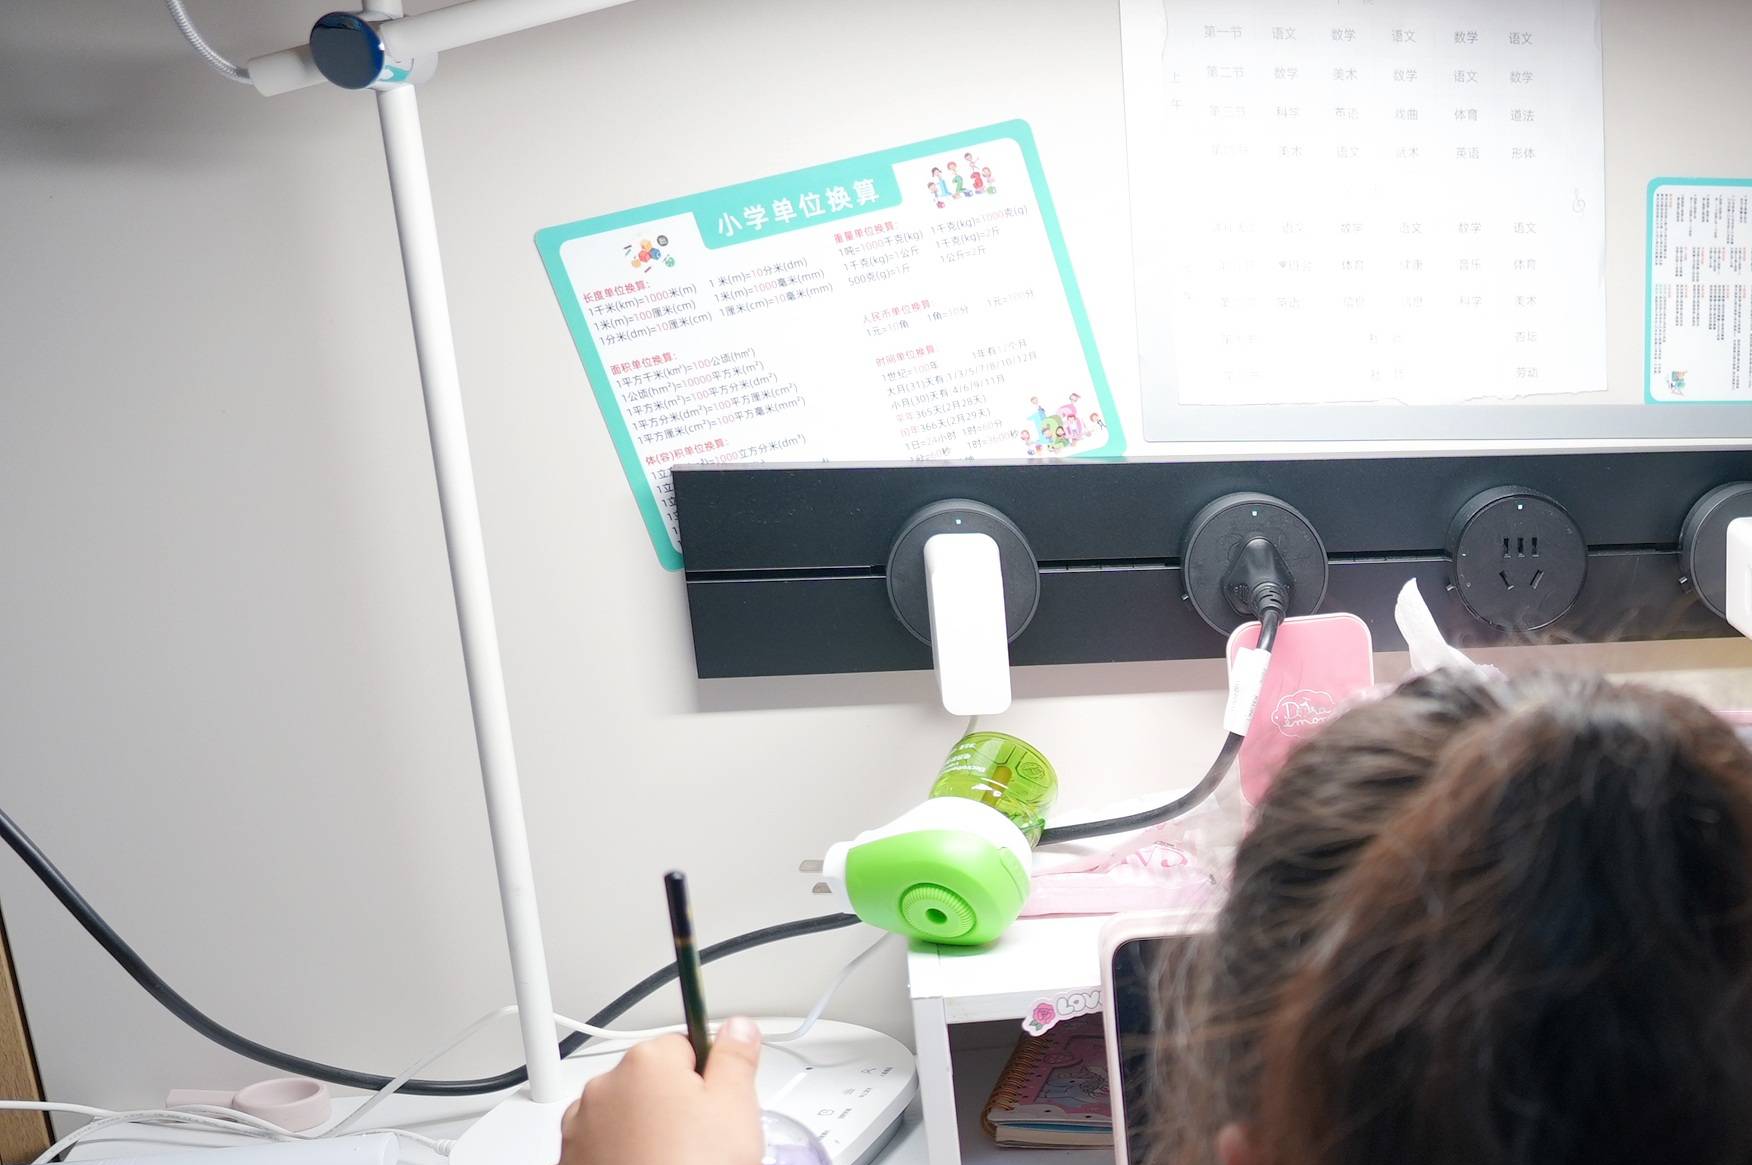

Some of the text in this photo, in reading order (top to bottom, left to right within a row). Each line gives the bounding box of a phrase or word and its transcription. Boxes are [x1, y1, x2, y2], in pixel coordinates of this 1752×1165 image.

[1204, 25, 1243, 40] 第一节
[1272, 27, 1297, 40] 语文
[1332, 28, 1357, 42] 数学
[1392, 30, 1417, 43] 语文
[1454, 31, 1479, 45] 数学
[1509, 32, 1534, 46] 语文
[1206, 65, 1246, 80] 第二节
[1274, 67, 1299, 80] 数学
[1333, 68, 1358, 81] 美术
[1393, 69, 1418, 83] 数学
[1454, 70, 1479, 83] 语文
[1510, 71, 1534, 84] 数学
[1454, 108, 1478, 121] 体育
[1510, 109, 1535, 122] 道法
[1456, 147, 1480, 160] 英语
[1511, 147, 1536, 160] 形体
[718, 178, 880, 238] 小学单位换算
[1458, 222, 1482, 235] 数学
[1513, 222, 1537, 235] 语文
[1513, 258, 1537, 272] 体育
[583, 279, 650, 304] 长度单位换算：
[714, 270, 825, 303] 1米(m)=1000毫米(mm)
[588, 284, 698, 317] 1千米(km)=1000米(m)
[720, 283, 834, 317] 1厘米(cm)=10毫米(mm)
[594, 300, 697, 332] 1米(m)=100厘米(cm)
[600, 312, 713, 346] 1分米(dm)=10厘米(cm)
[610, 351, 677, 376] 面积单位换算：
[645, 438, 729, 466] 体(容)积单位换算：
[1056, 990, 1103, 1016] LOV
